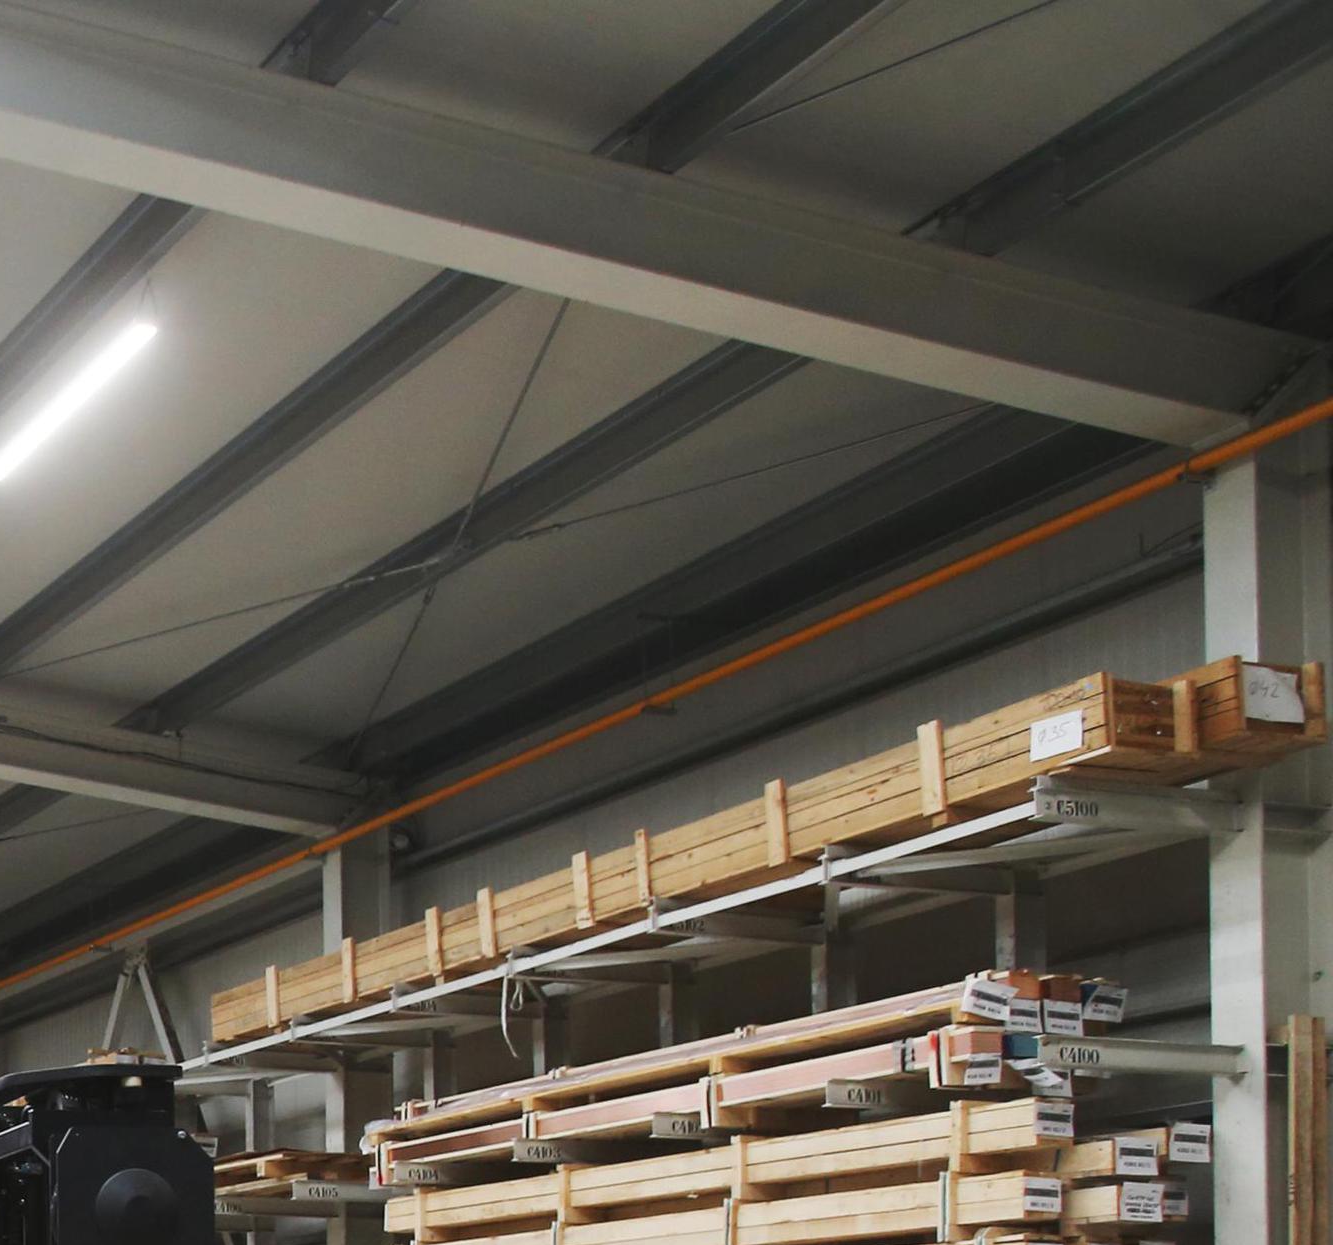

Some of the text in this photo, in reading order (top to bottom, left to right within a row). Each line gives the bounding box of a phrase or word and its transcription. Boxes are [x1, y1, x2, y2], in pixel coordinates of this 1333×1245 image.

[1057, 800, 1099, 817] C5100
[1059, 1046, 1101, 1064] C4100
[526, 1145, 561, 1160] C4103
[407, 1168, 439, 1181] C4104
[308, 1187, 339, 1198] C4105
